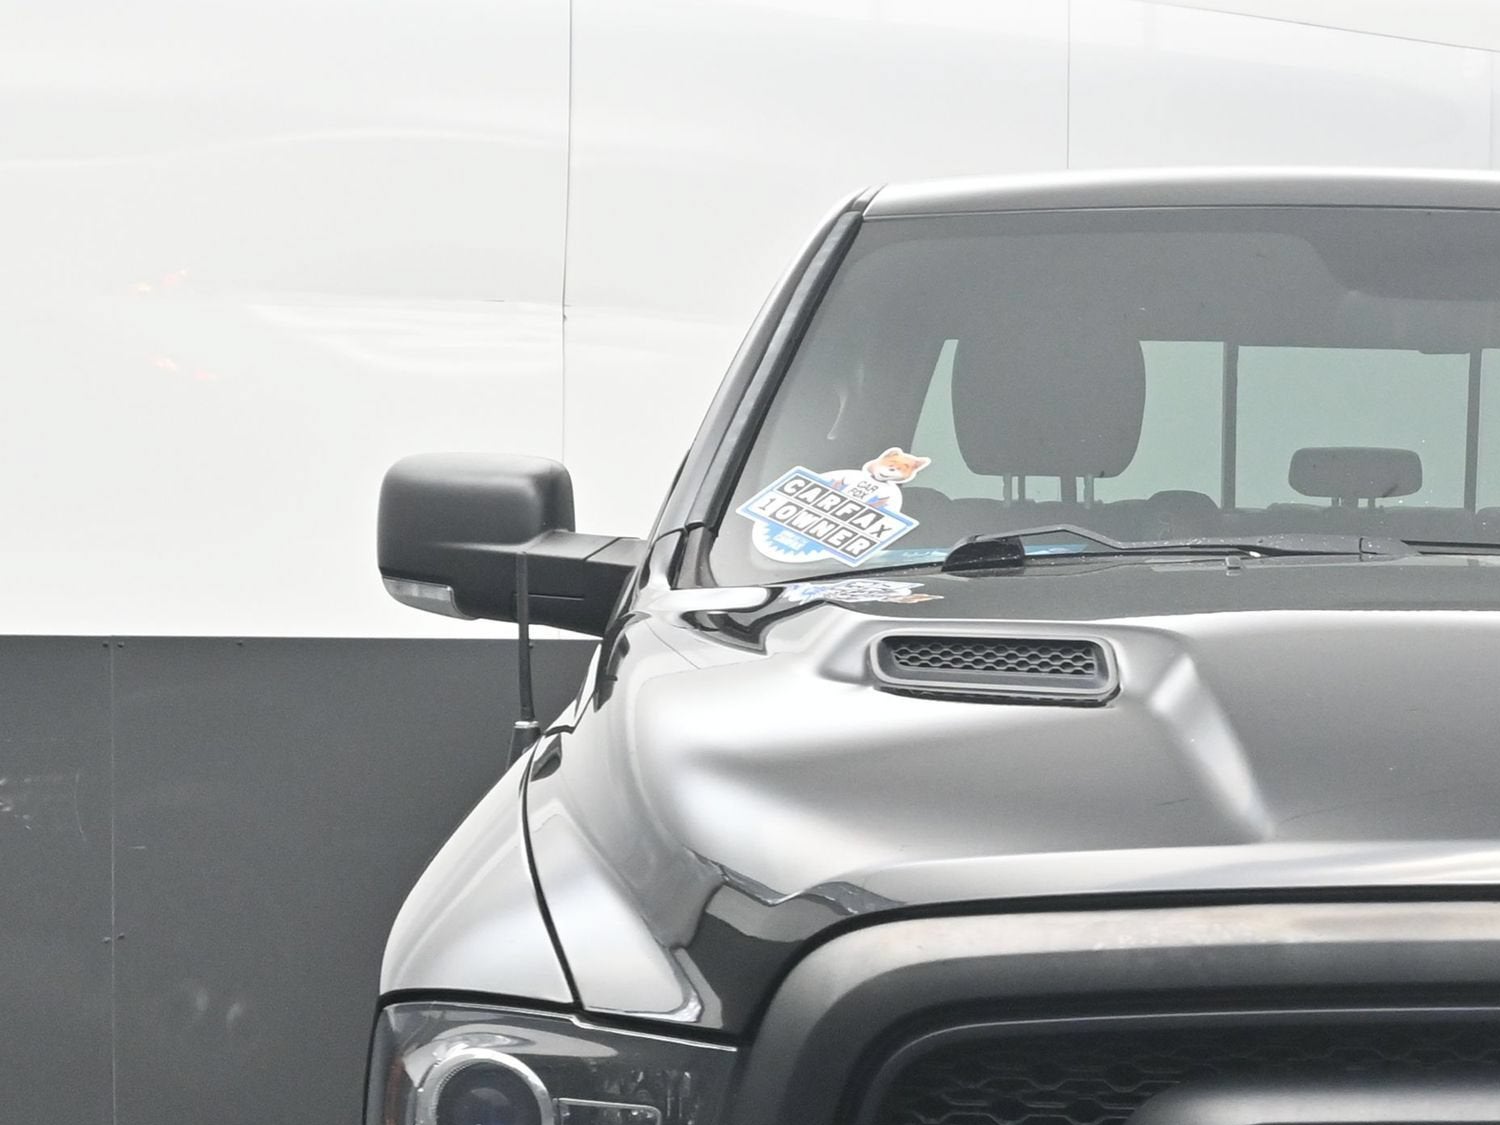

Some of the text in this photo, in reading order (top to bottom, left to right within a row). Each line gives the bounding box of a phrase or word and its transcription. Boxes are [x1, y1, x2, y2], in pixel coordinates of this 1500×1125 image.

[758, 497, 775, 512] 1
[770, 504, 877, 558] OWNER
[777, 476, 892, 539] CARFAX
